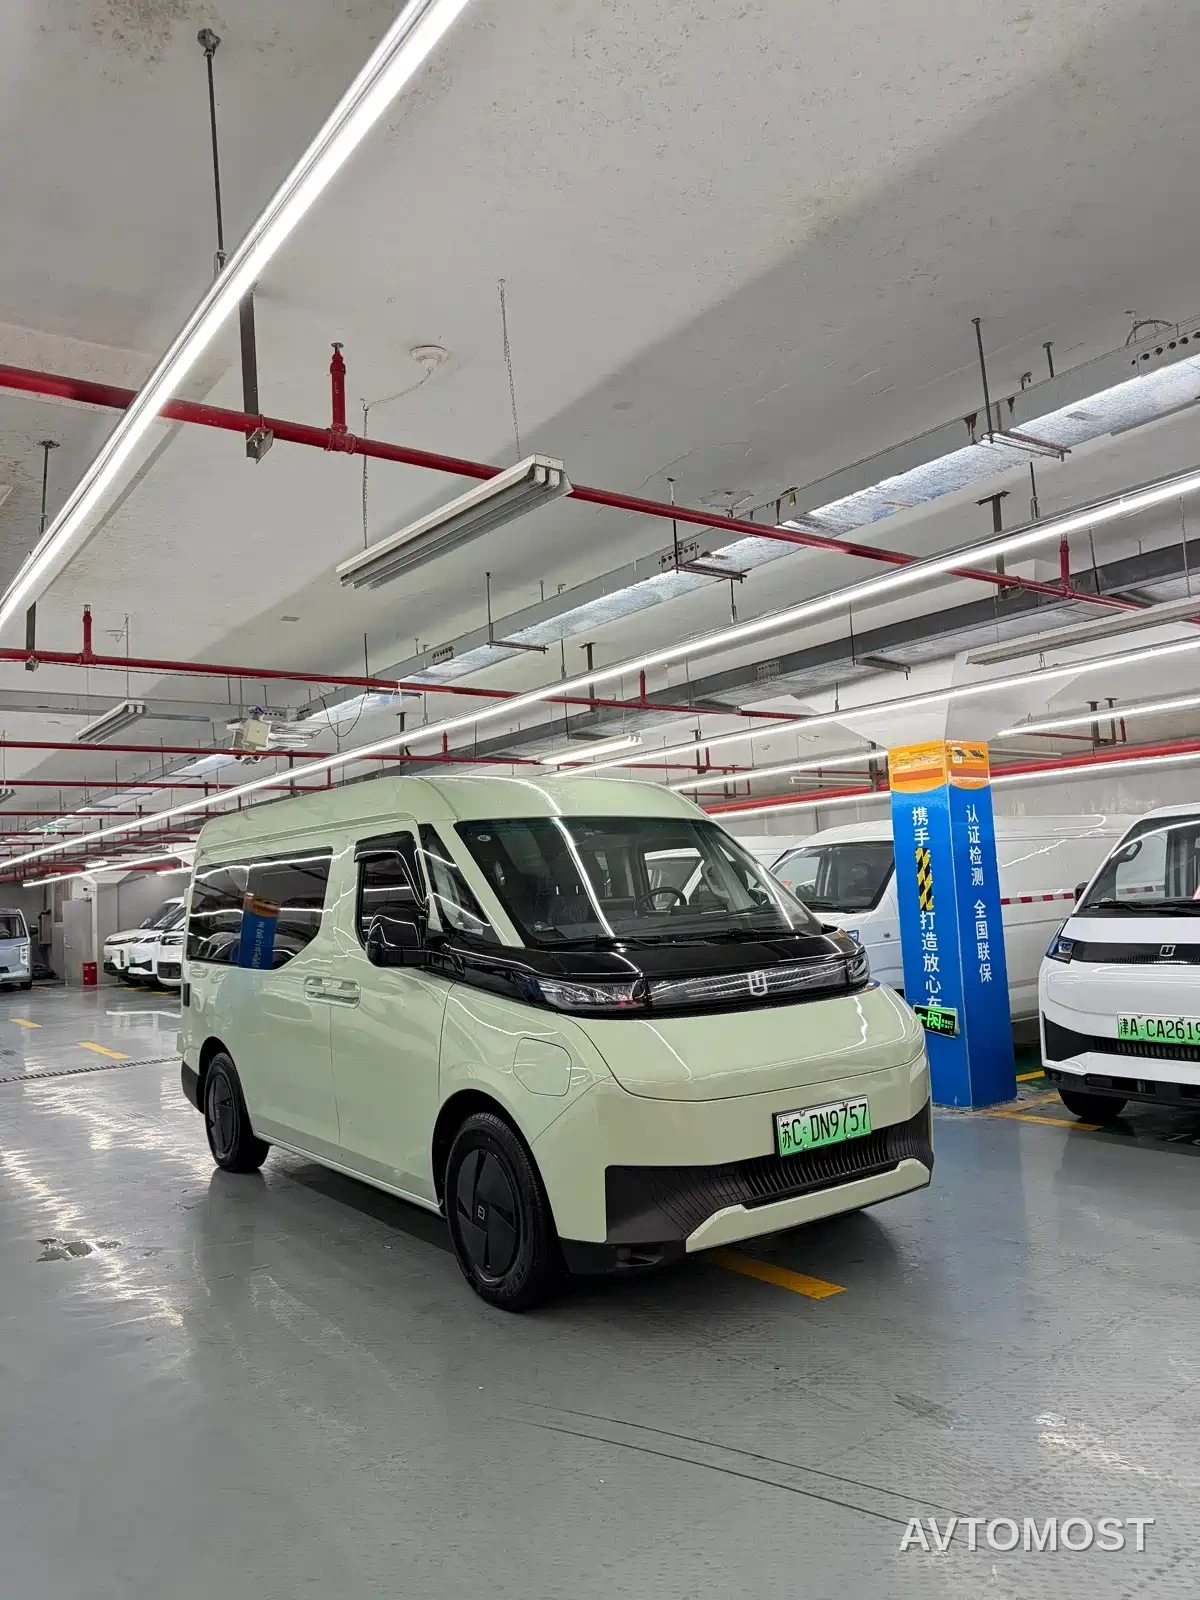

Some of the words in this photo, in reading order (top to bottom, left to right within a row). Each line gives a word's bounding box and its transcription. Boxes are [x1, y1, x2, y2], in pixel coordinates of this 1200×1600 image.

[966, 803, 985, 887] 认证检测
[973, 899, 993, 984] 全国联保
